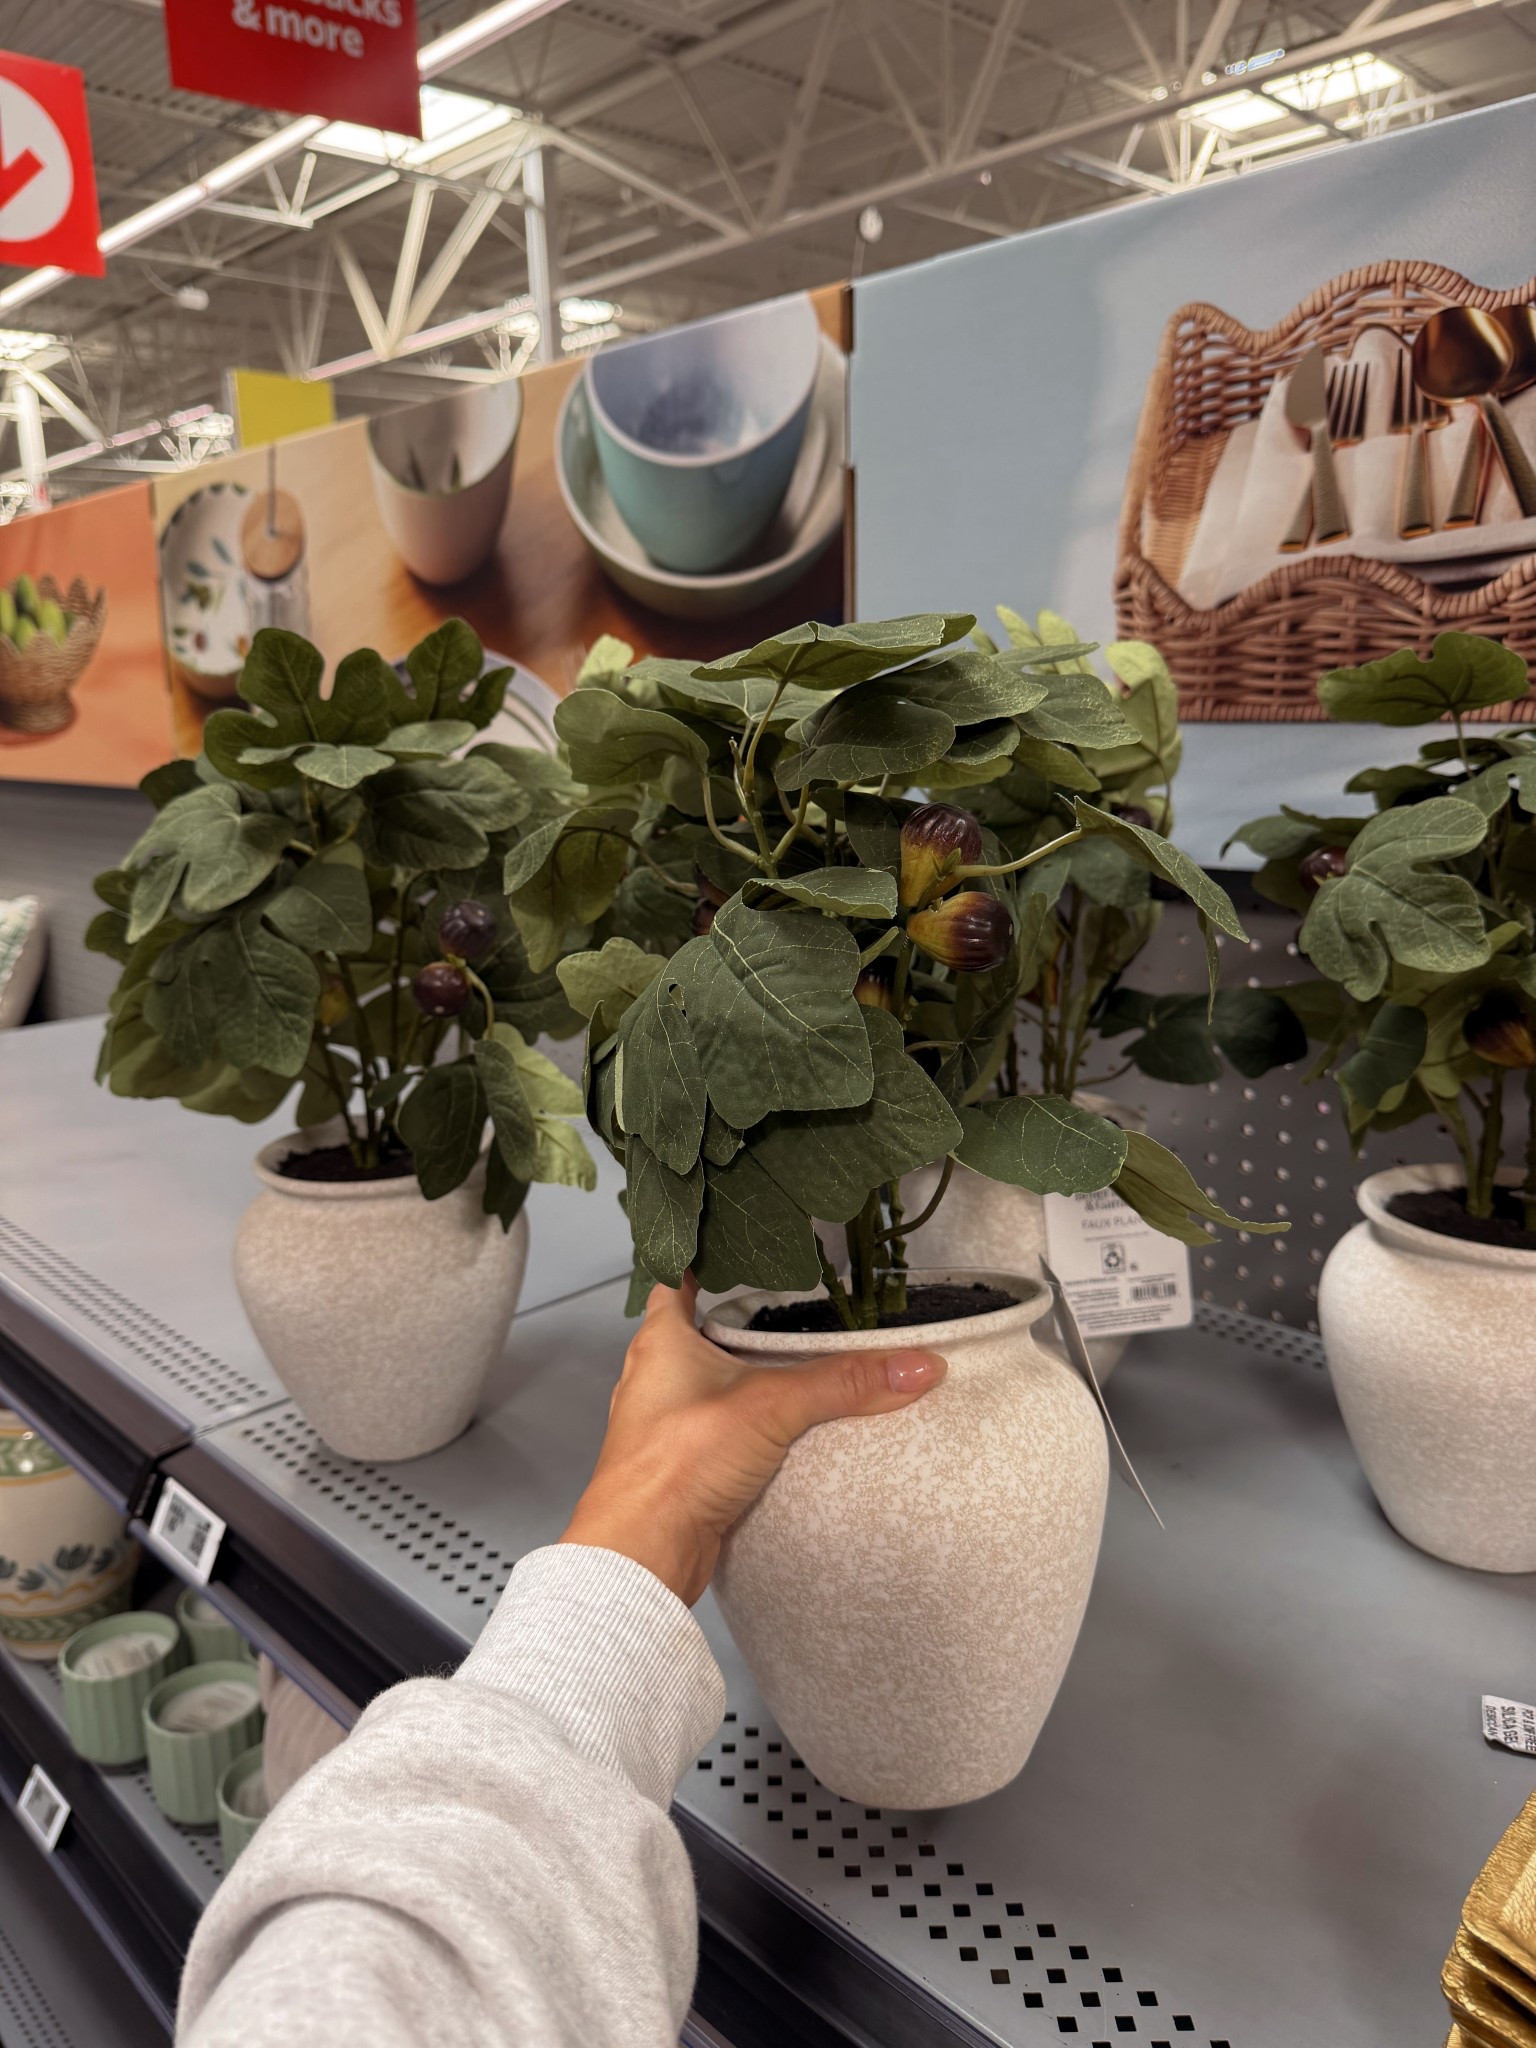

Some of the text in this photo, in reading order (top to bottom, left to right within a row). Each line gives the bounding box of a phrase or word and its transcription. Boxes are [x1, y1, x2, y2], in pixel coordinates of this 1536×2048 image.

[231, 0, 365, 58] & more
[1113, 1215, 1142, 1227] PLAN
[1501, 1706, 1517, 1729] SILICA
